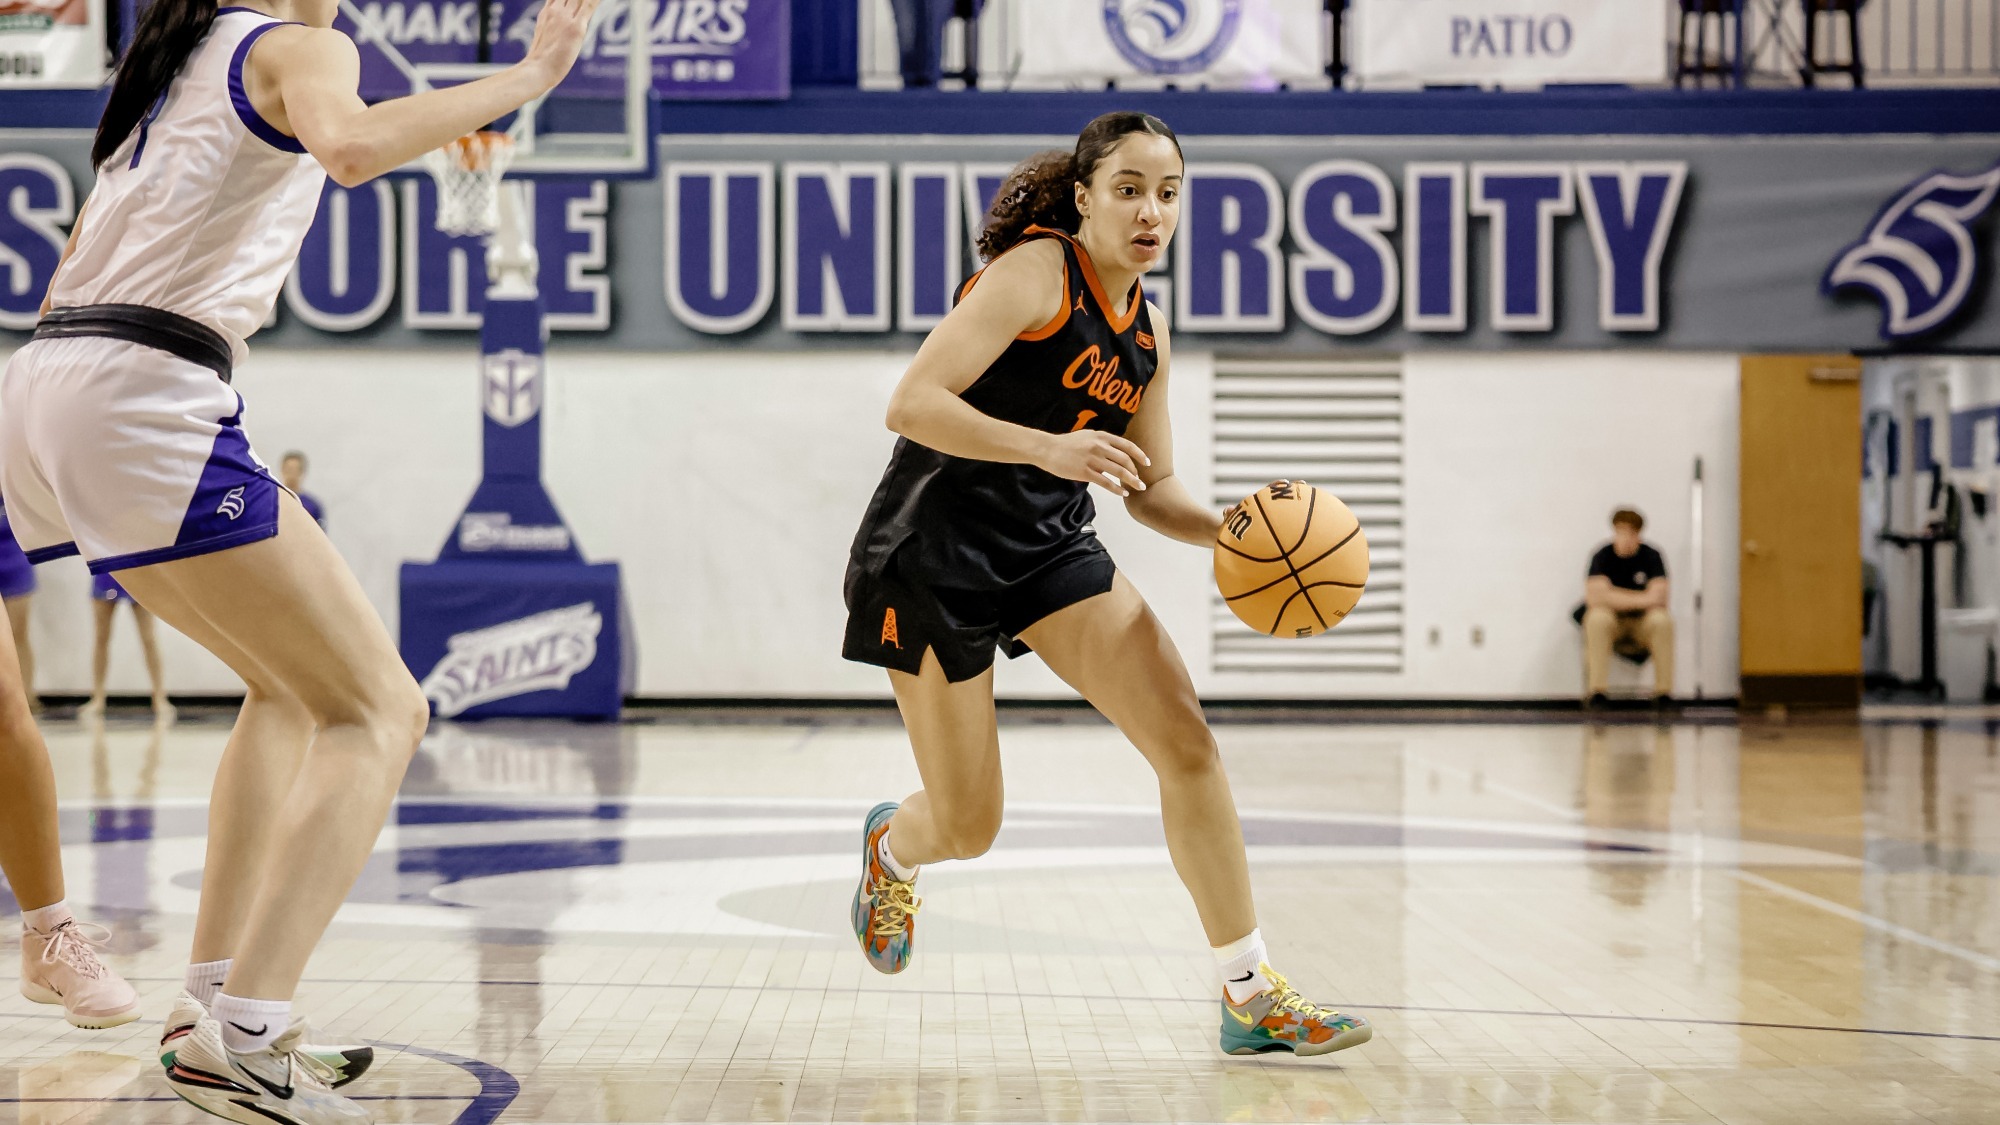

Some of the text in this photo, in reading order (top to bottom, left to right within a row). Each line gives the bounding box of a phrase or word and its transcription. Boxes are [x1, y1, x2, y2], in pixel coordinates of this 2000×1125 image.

[1450, 13, 1572, 57] PATIO
[663, 159, 1688, 335] UNIRSITY
[1062, 344, 1143, 414] Oilers
